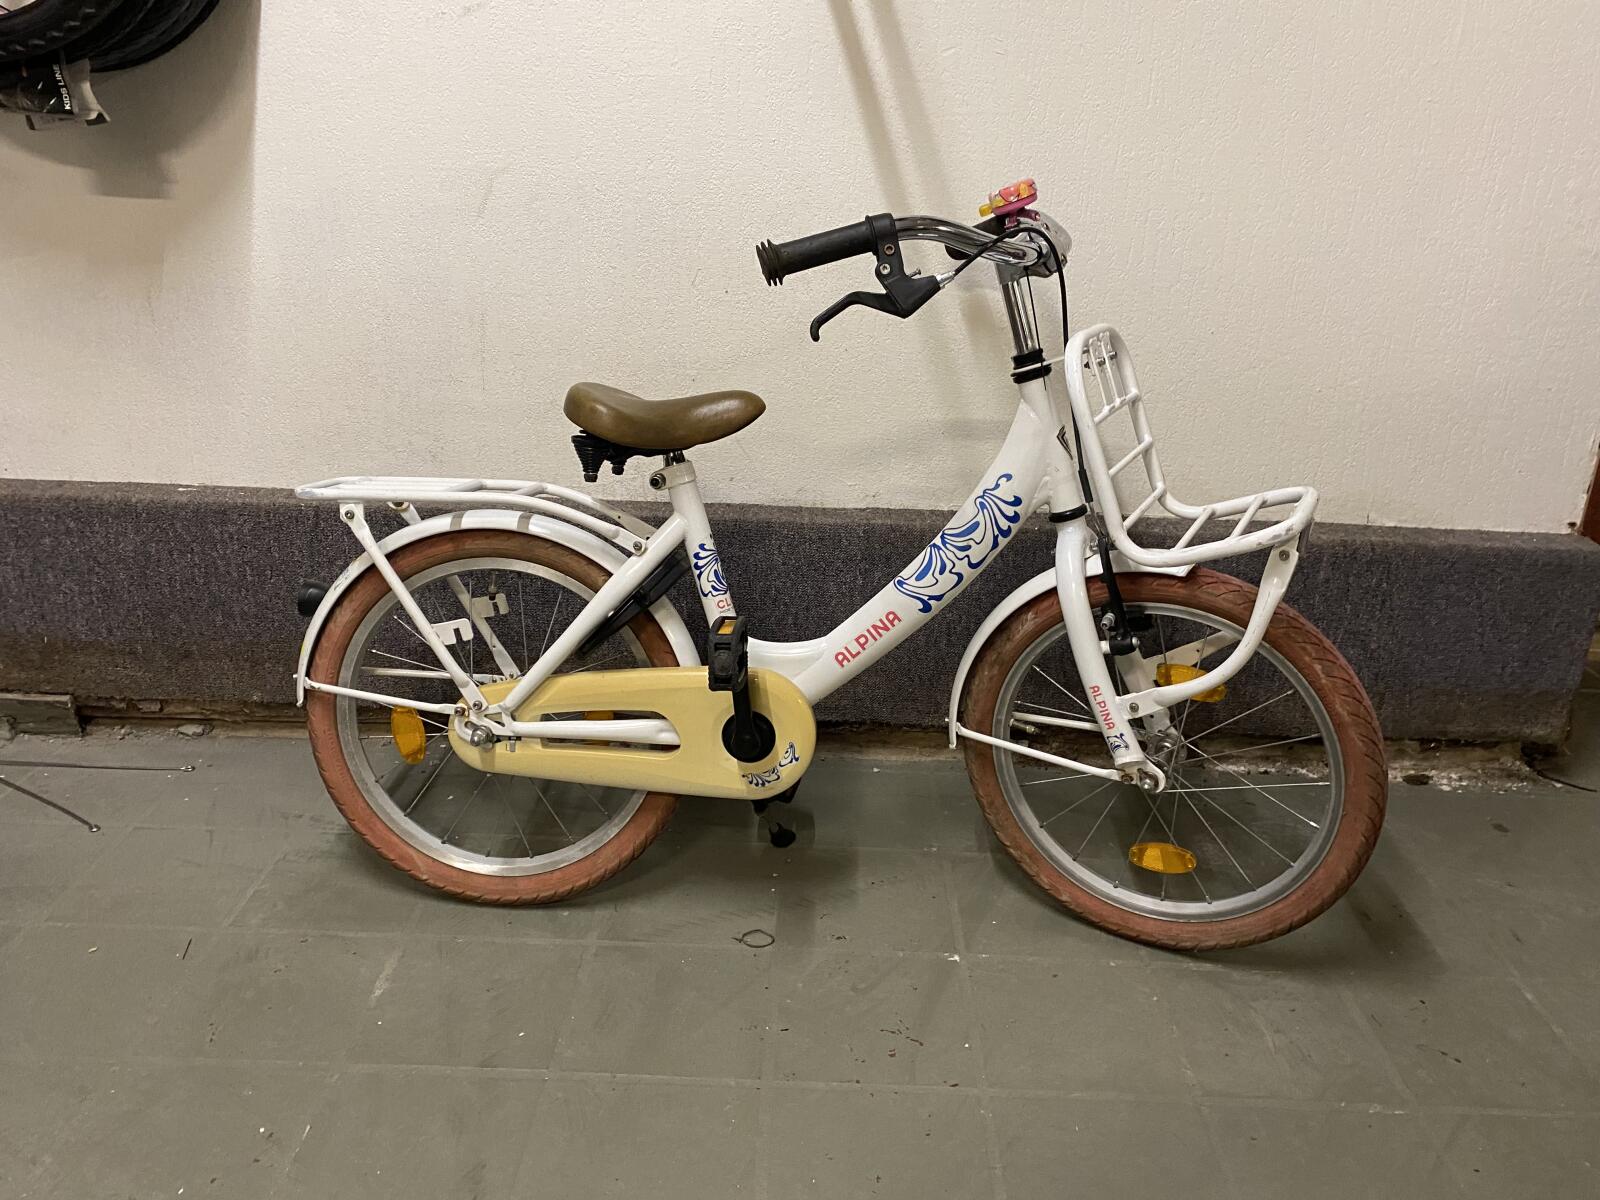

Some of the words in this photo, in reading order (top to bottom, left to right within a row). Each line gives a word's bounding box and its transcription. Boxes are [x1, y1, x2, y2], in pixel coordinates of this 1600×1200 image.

[52, 63, 65, 86] LINE
[60, 87, 71, 110] KIDS
[834, 610, 902, 668] ALPINA
[1089, 684, 1115, 730] ALPINA
